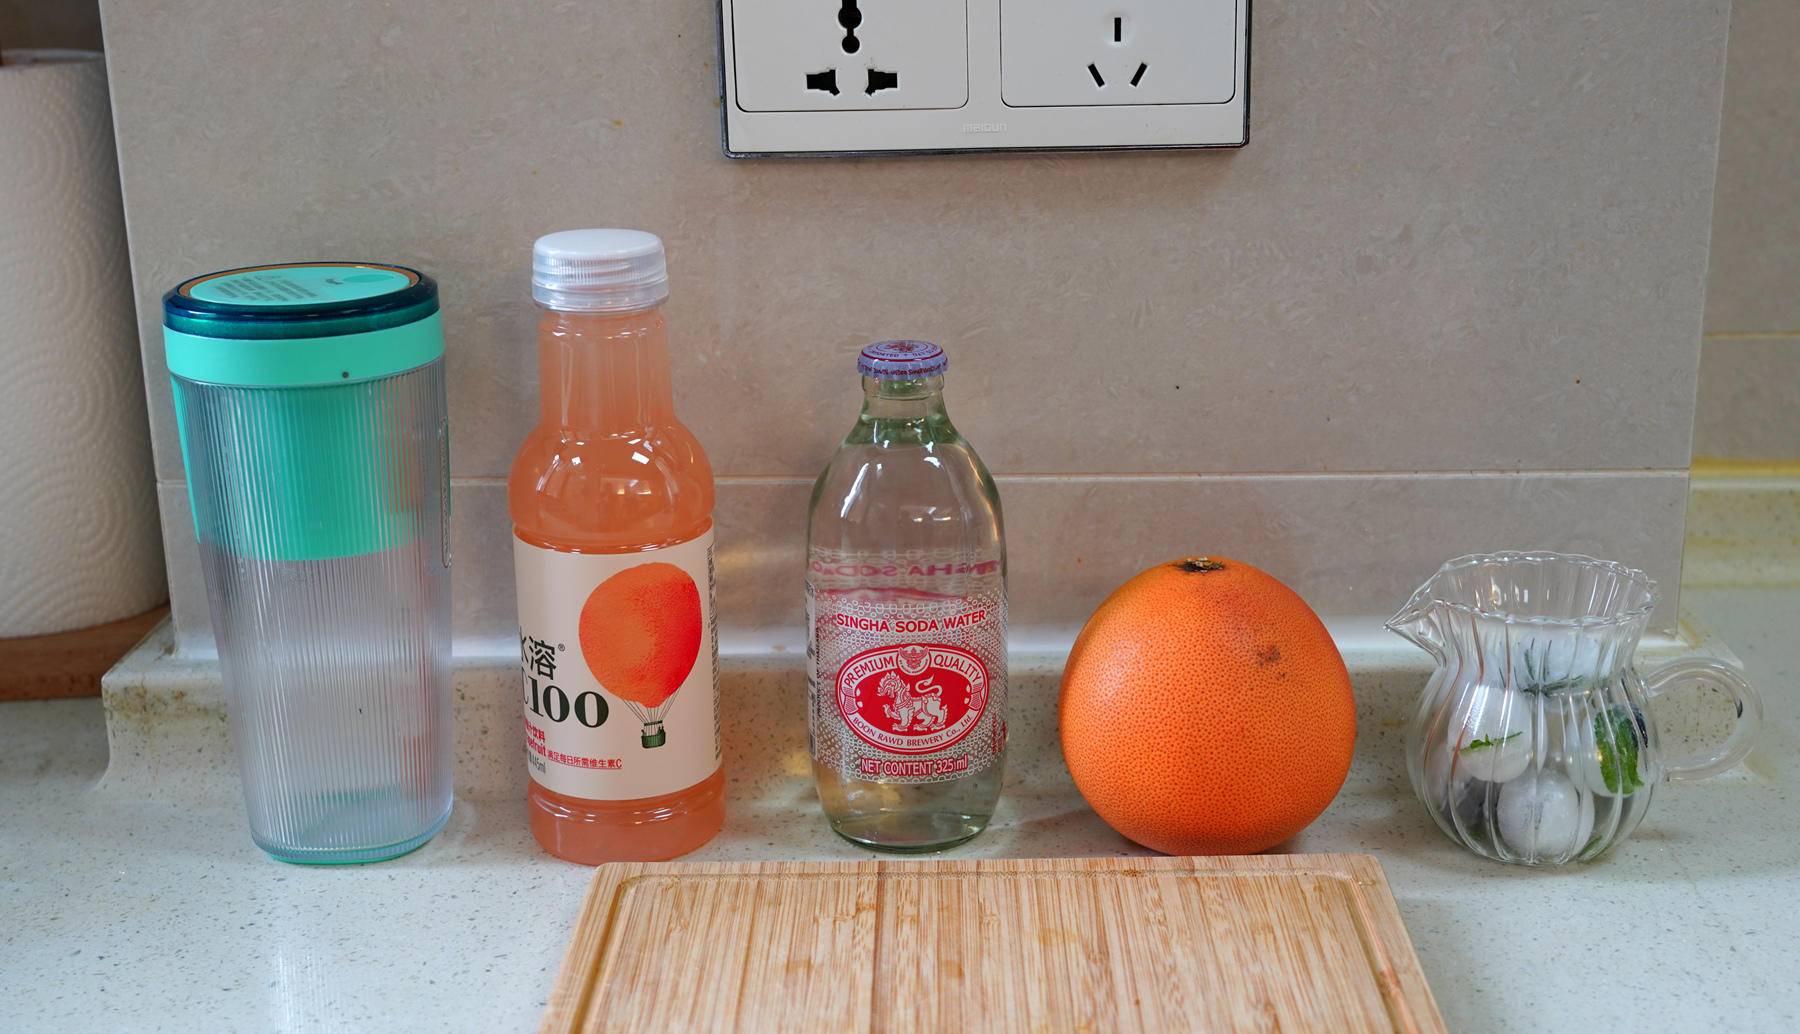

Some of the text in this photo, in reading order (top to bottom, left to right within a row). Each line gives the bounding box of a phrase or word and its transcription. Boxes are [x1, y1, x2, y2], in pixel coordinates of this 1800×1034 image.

[837, 610, 986, 633] SINGHA SODA WATER
[844, 655, 895, 688] PREMIUM
[933, 656, 982, 685] QUALITY
[853, 717, 876, 738] BOON
[877, 733, 904, 746] RAWD
[906, 734, 944, 747] BREWERY
[860, 754, 968, 776] NET CONTENT 325 ml
